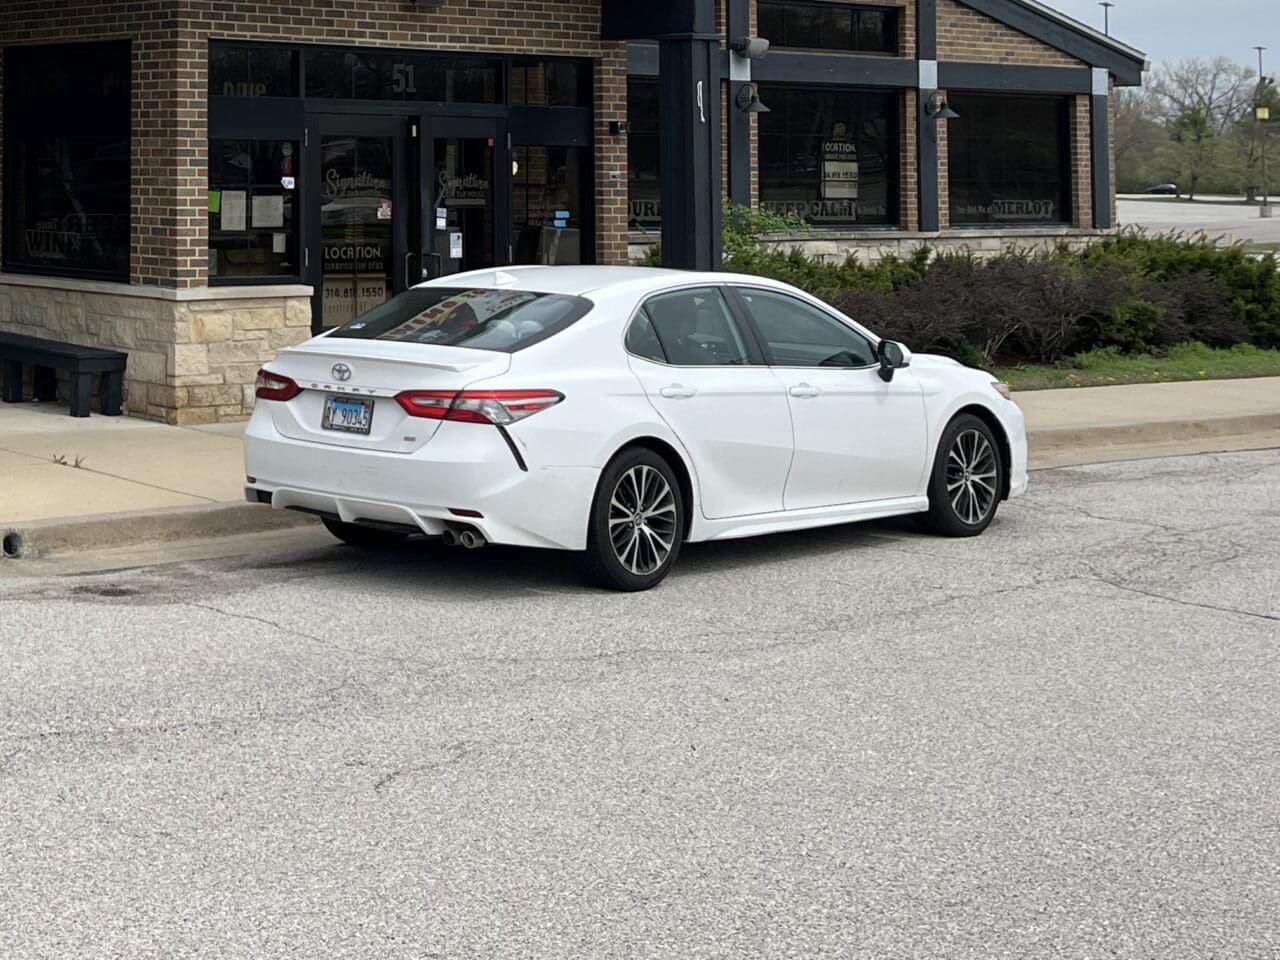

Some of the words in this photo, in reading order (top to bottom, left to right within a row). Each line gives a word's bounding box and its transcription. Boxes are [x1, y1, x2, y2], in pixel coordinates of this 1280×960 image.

[391, 63, 417, 93] 51
[993, 200, 1053, 218] MERLOT
[311, 383, 376, 393] CAMRY
